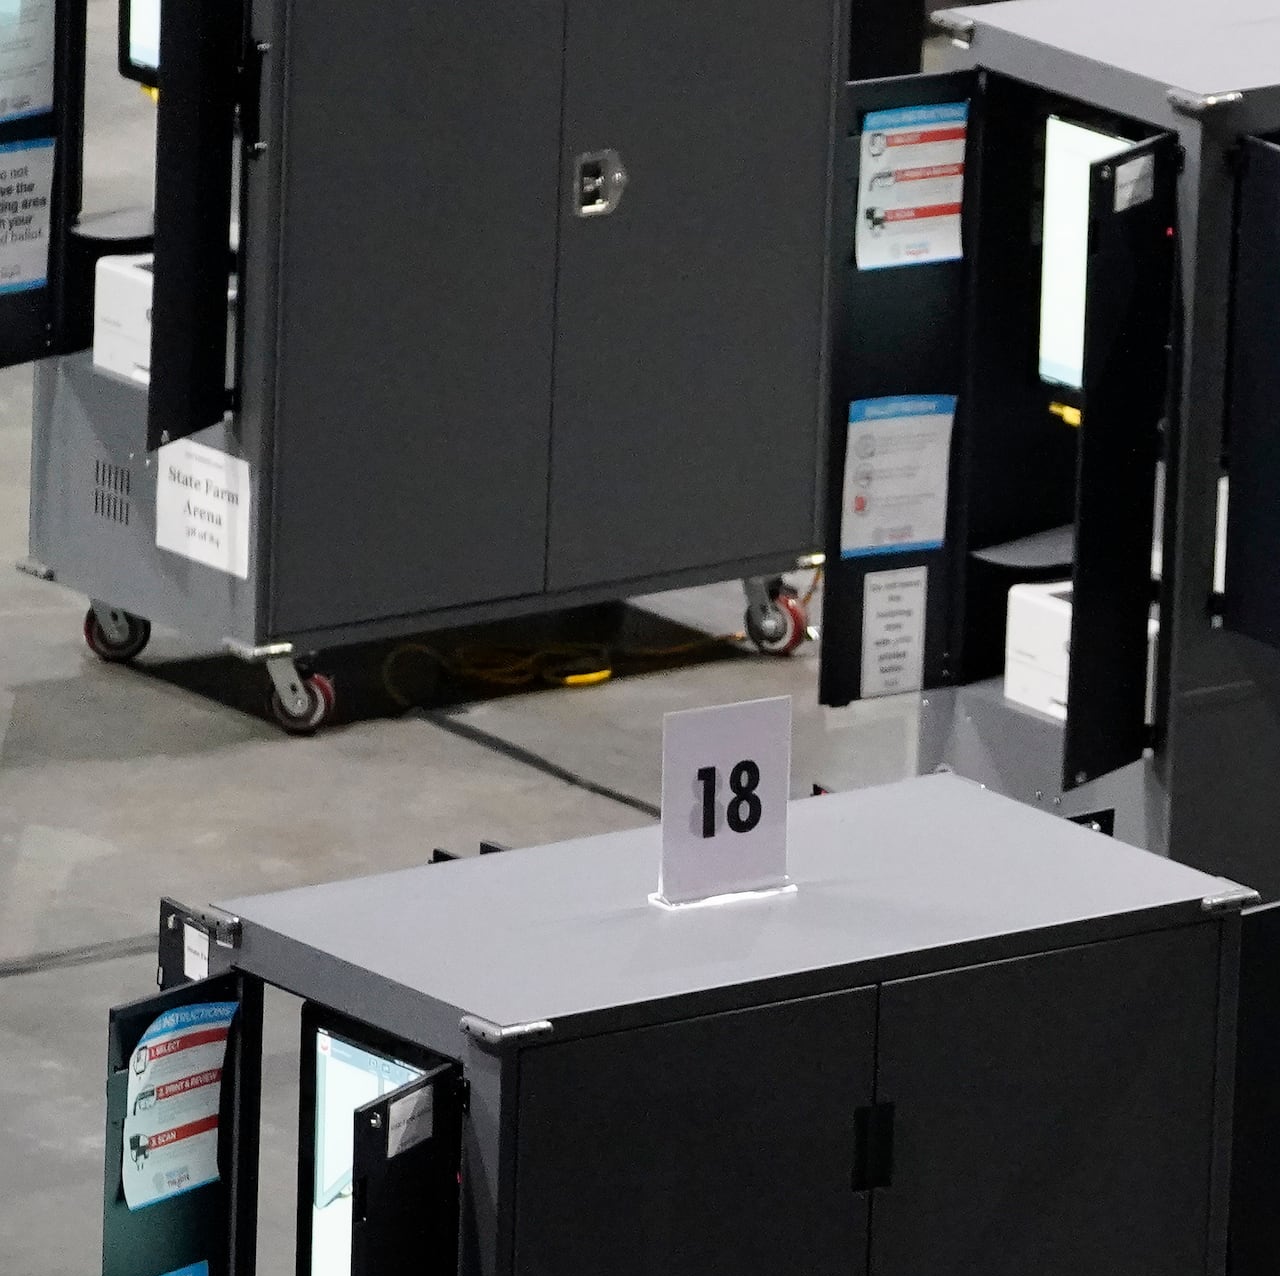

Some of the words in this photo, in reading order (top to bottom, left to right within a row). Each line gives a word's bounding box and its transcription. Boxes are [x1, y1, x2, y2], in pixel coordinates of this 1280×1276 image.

[169, 466, 200, 489] State
[206, 479, 239, 506] Farm
[185, 499, 222, 526] Arena
[698, 760, 762, 838] 18
[156, 1041, 180, 1053] SELECT
[158, 1132, 177, 1145] SCAN
